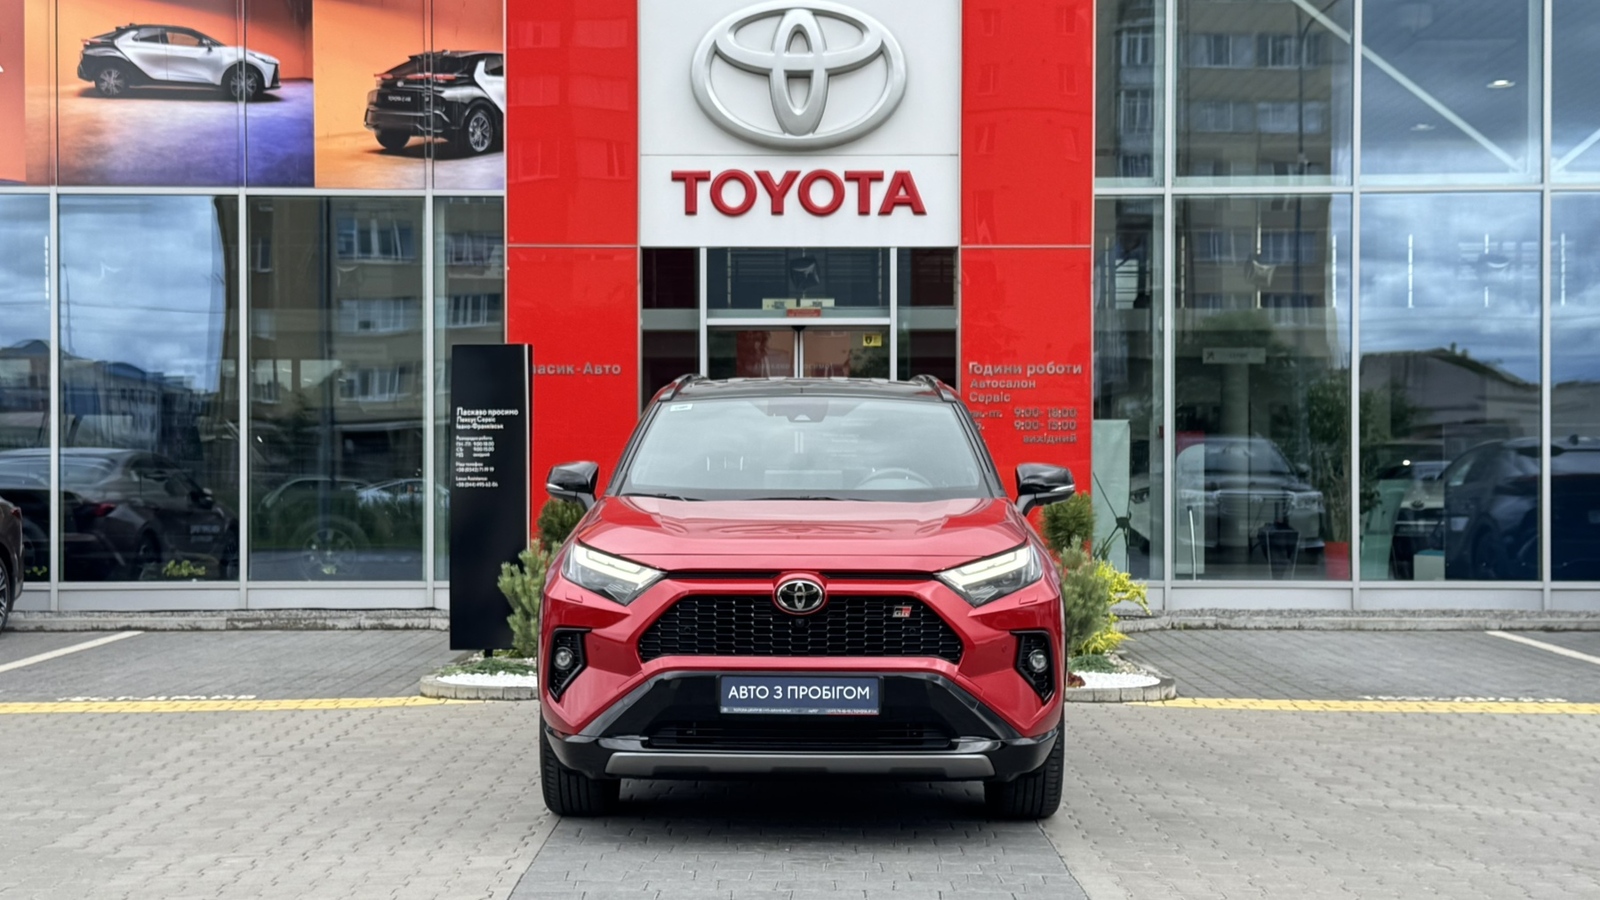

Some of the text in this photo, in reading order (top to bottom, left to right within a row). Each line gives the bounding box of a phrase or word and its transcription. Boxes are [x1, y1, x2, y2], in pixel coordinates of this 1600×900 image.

[671, 168, 927, 217] TOYOTA
[969, 361, 1082, 377] Години роботи
[970, 379, 1036, 389] Автосалон
[969, 391, 1011, 404] Сервіс
[487, 409, 519, 417] просимо
[1023, 432, 1077, 444] вихідний
[728, 685, 769, 700] АВТО
[787, 685, 870, 700] ПРОБІГОМ
